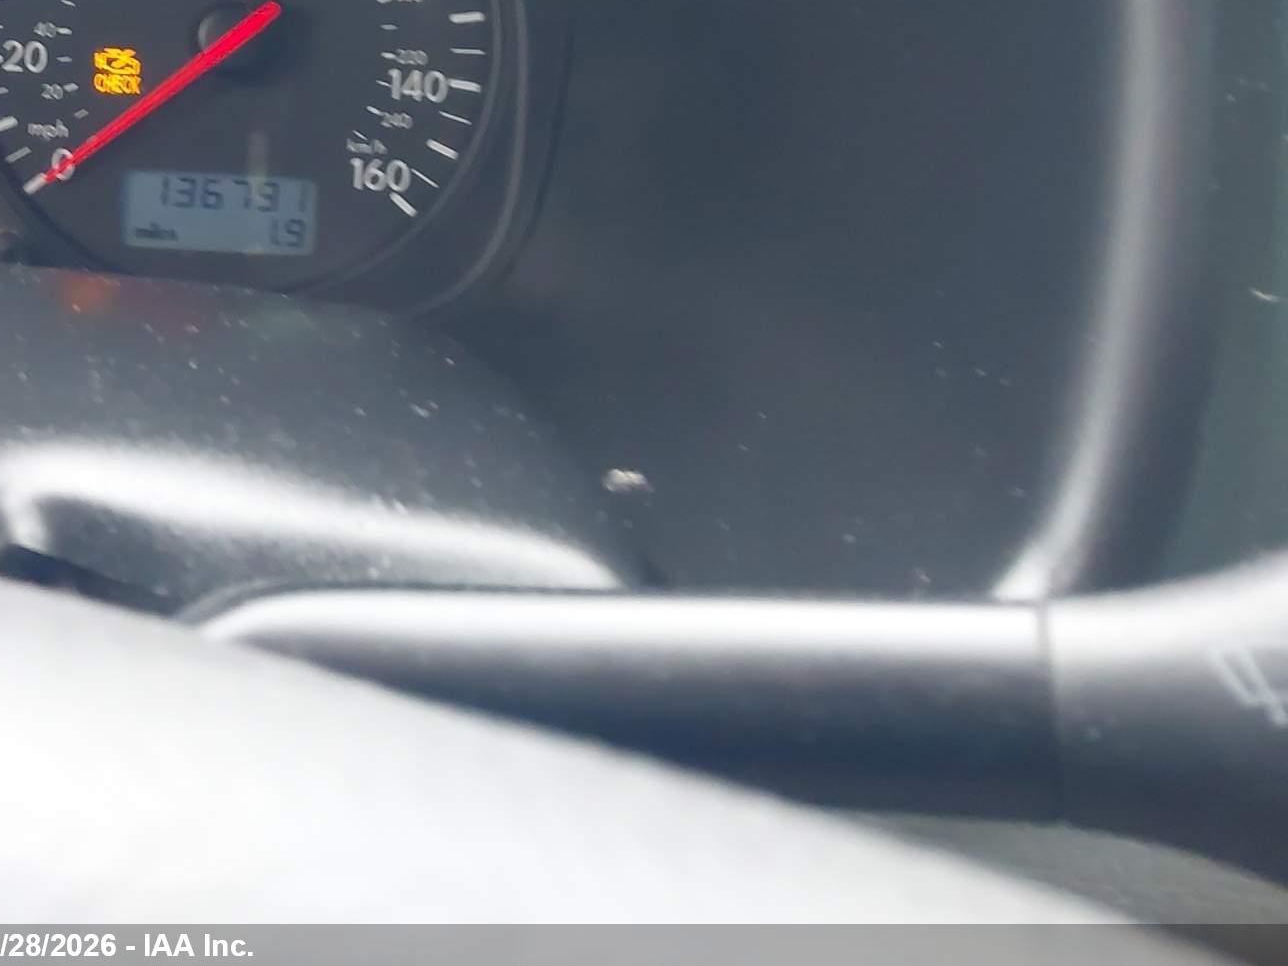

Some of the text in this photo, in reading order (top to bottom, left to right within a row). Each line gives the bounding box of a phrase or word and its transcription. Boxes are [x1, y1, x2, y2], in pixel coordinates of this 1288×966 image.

[1, 40, 48, 74] 20
[93, 73, 141, 95] CHECK
[387, 68, 448, 103] 140
[28, 119, 69, 141] mph
[52, 148, 75, 181] 0
[350, 157, 410, 192] 160
